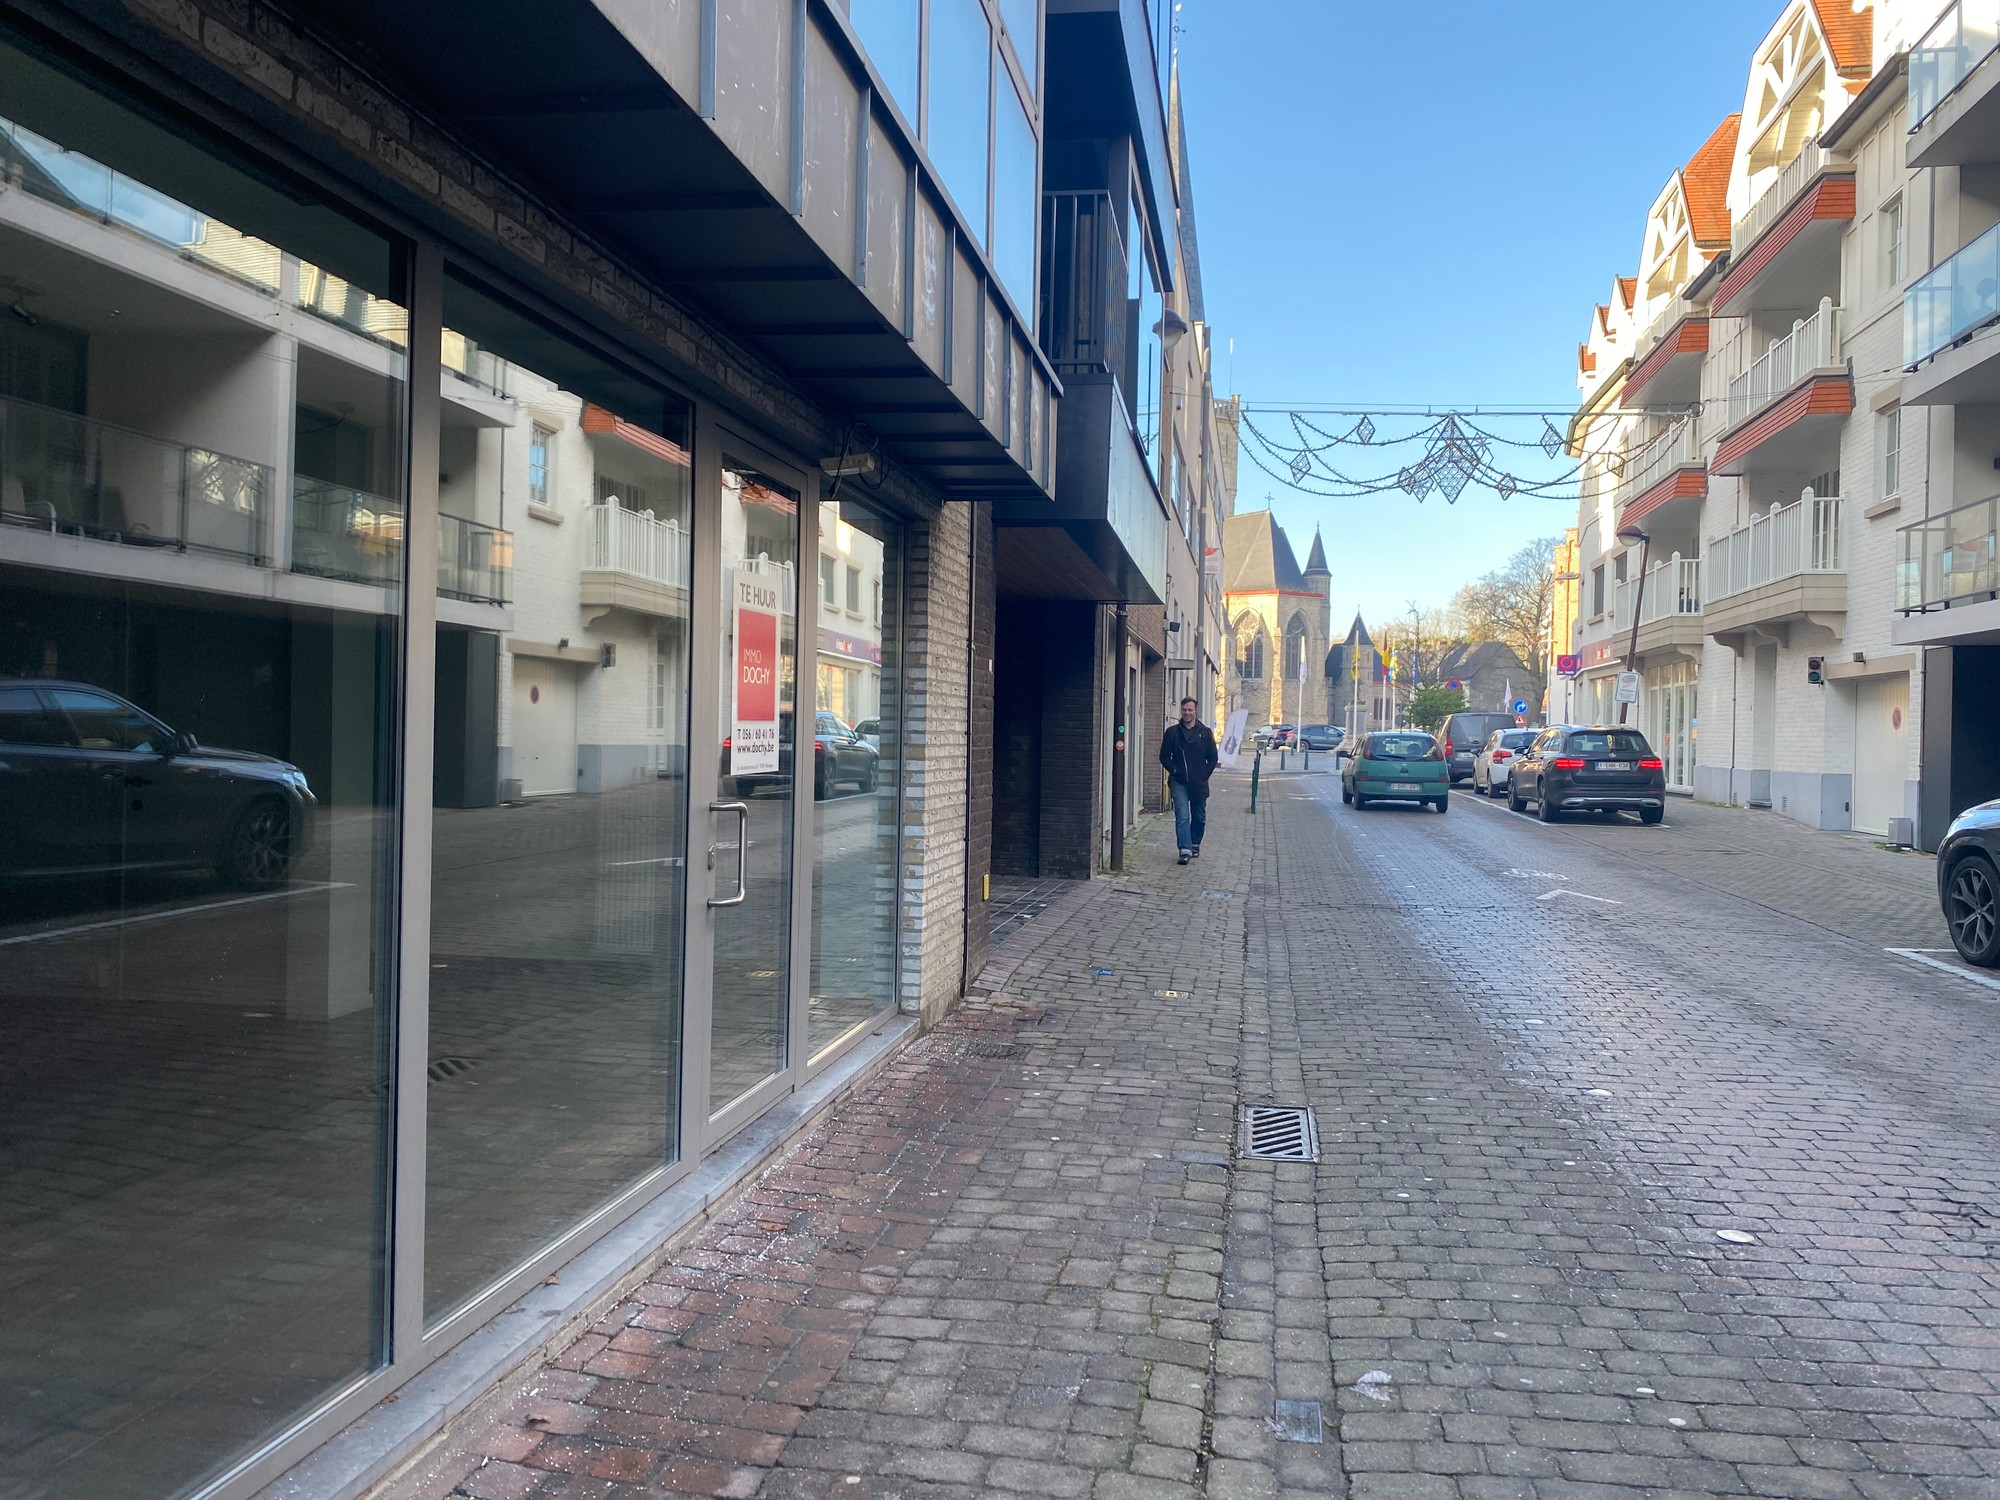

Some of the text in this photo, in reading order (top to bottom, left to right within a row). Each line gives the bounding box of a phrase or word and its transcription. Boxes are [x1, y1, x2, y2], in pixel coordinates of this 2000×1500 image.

[740, 582, 776, 610] TE HUUR
[744, 648, 762, 664] IMMO
[743, 665, 771, 685] DOCHY
[737, 741, 775, 756] www.dochy.be
